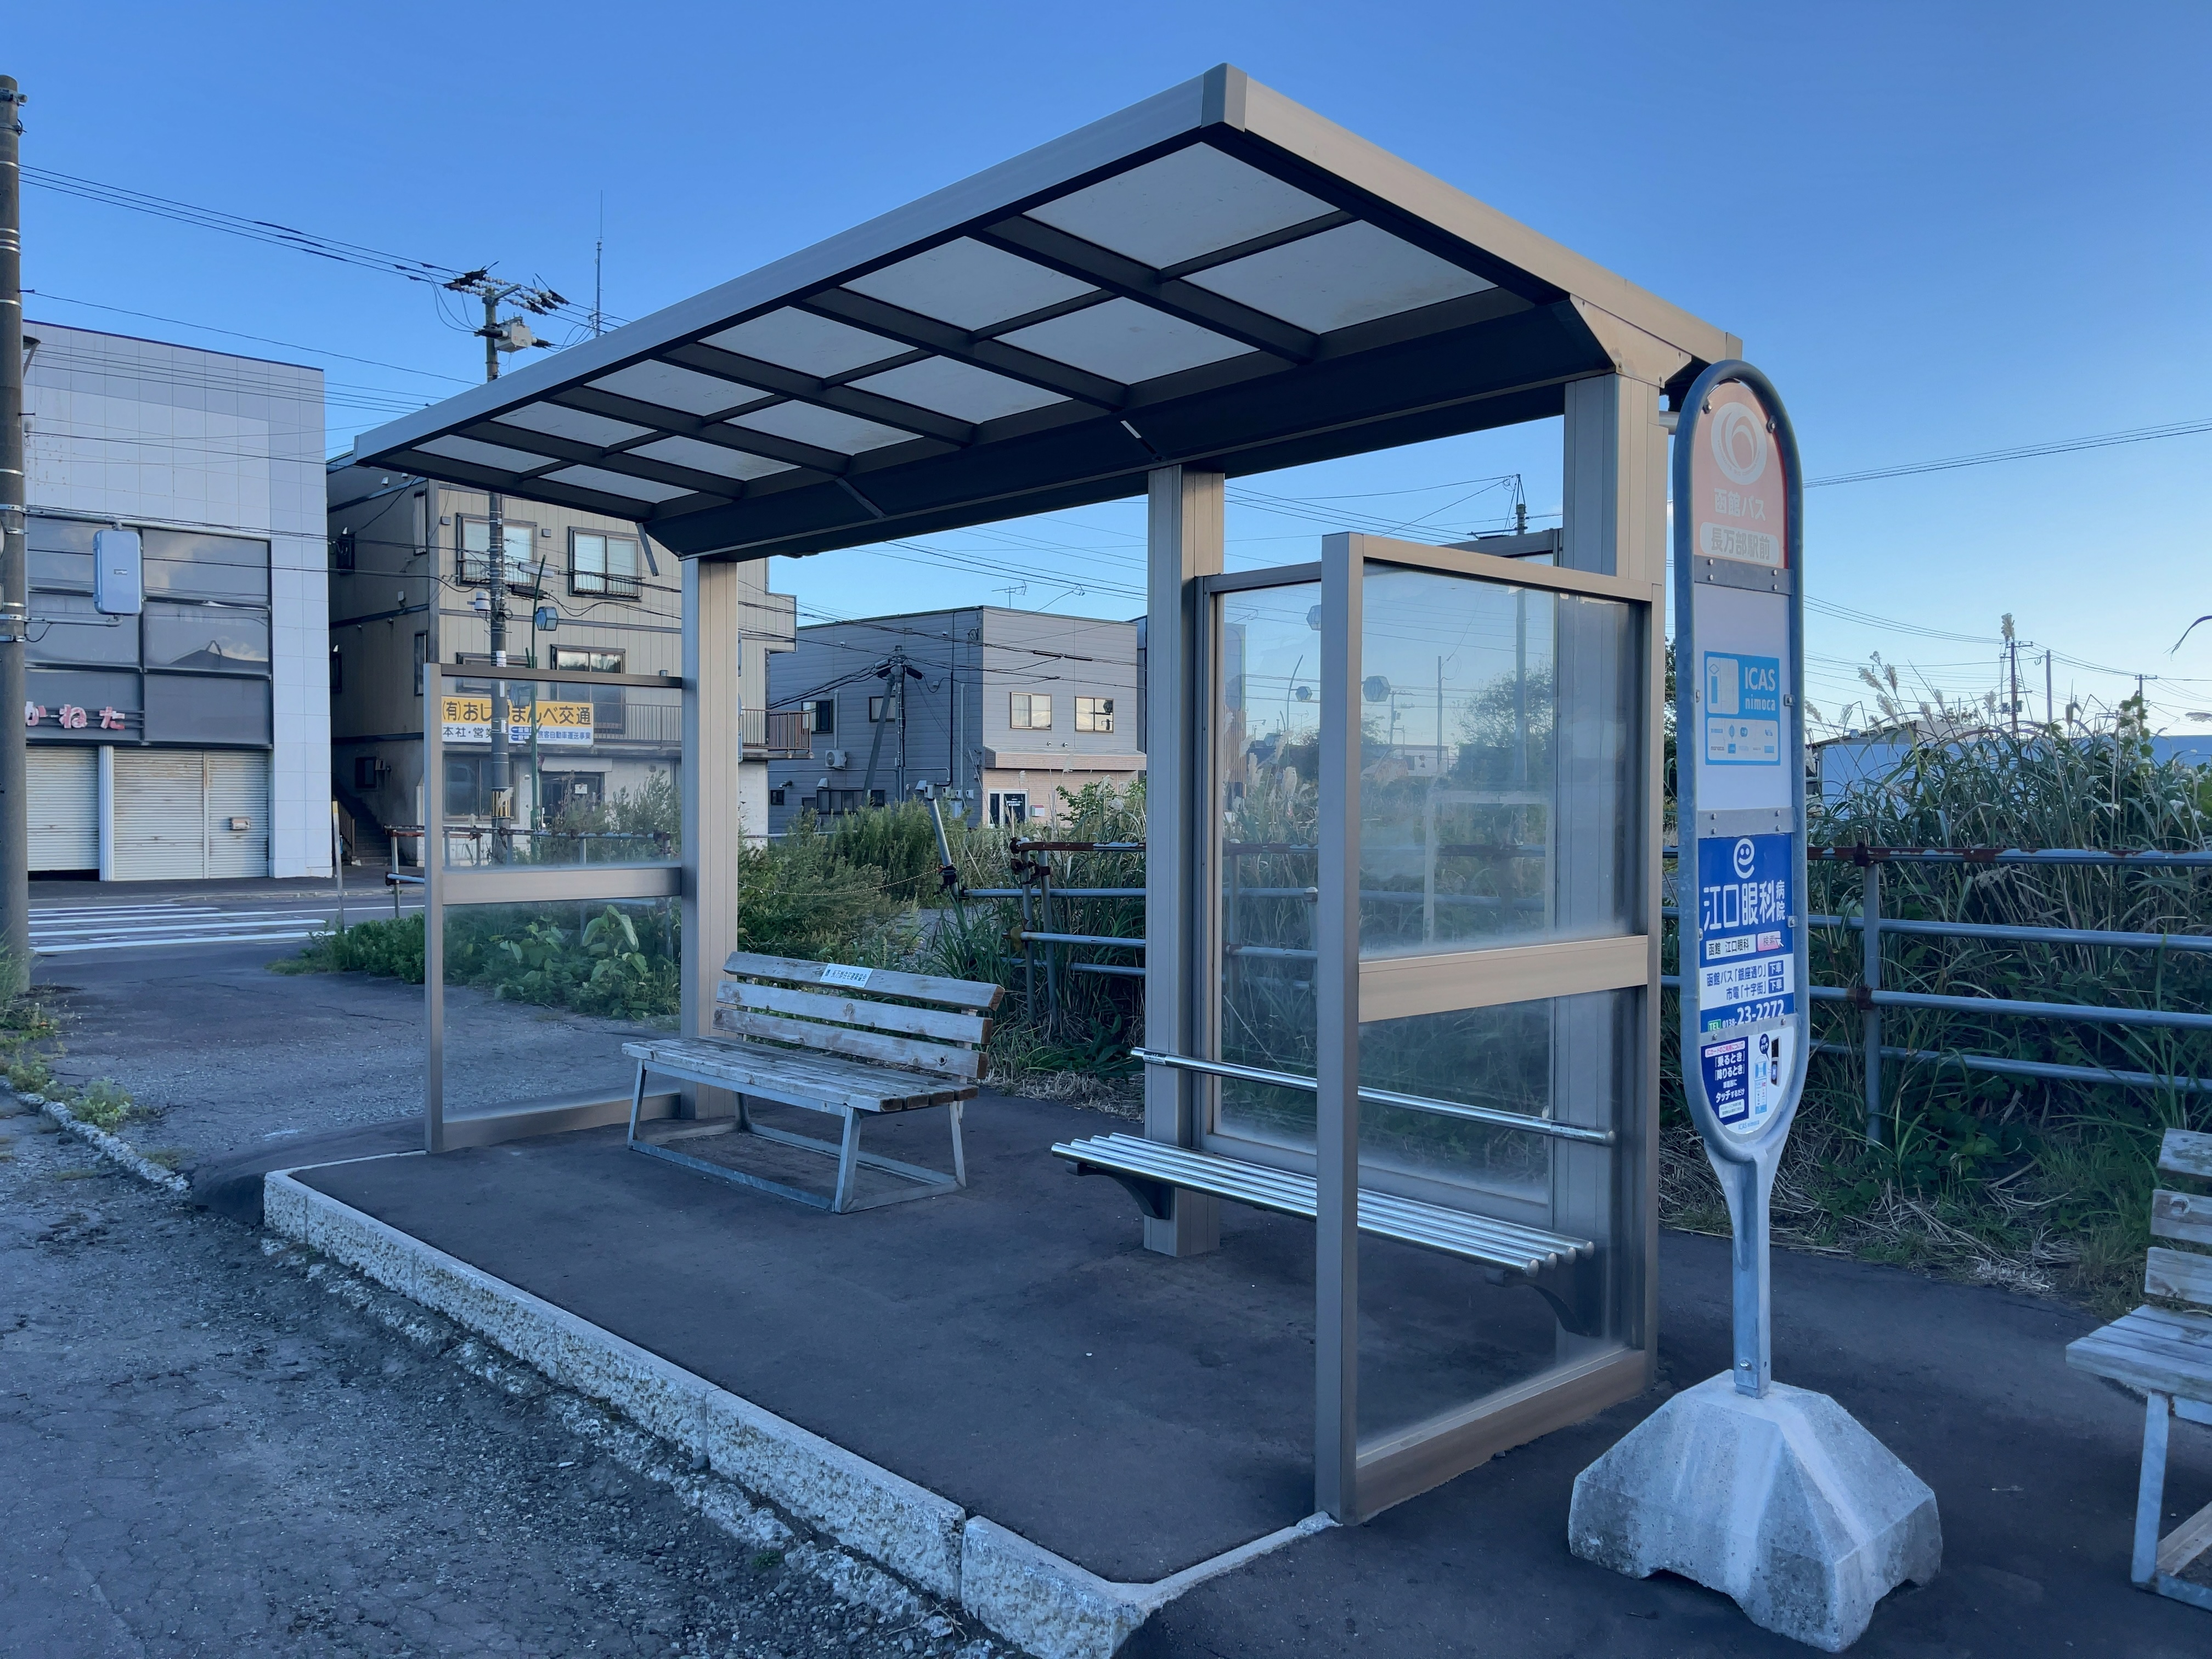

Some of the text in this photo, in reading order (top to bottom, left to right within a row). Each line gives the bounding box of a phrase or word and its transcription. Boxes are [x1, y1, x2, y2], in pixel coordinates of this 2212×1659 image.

[1714, 488, 1766, 521] 函館バス
[1711, 527, 1770, 560] 長万部駅前
[1745, 667, 1776, 691] ICAS
[442, 700, 591, 725] (有)おしまんべ交通
[1745, 694, 1776, 711] nimoca
[1709, 1022, 1720, 1031] TEL
